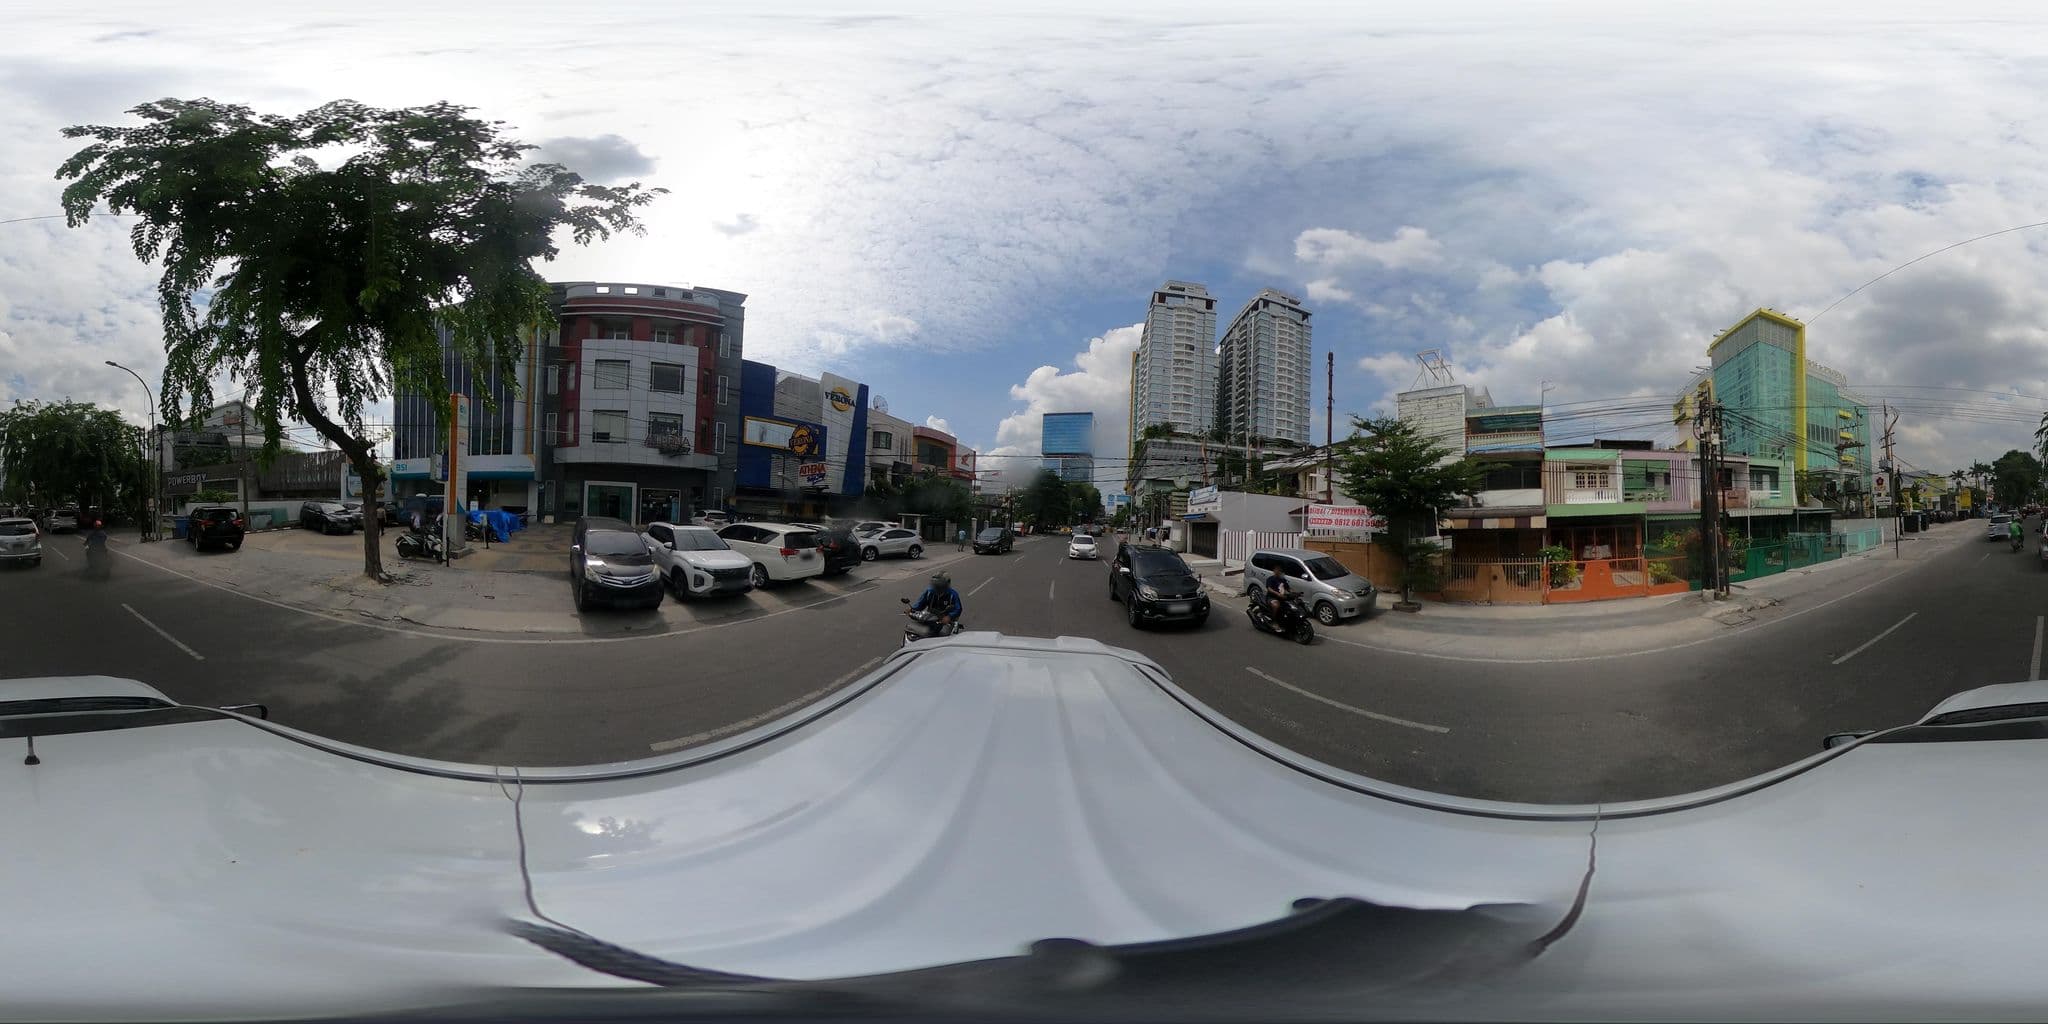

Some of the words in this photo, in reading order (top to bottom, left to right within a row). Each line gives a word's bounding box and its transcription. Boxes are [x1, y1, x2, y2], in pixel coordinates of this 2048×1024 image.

[824, 391, 857, 407] VERONA
[396, 463, 408, 471] BSI
[799, 463, 826, 476] ATHENA
